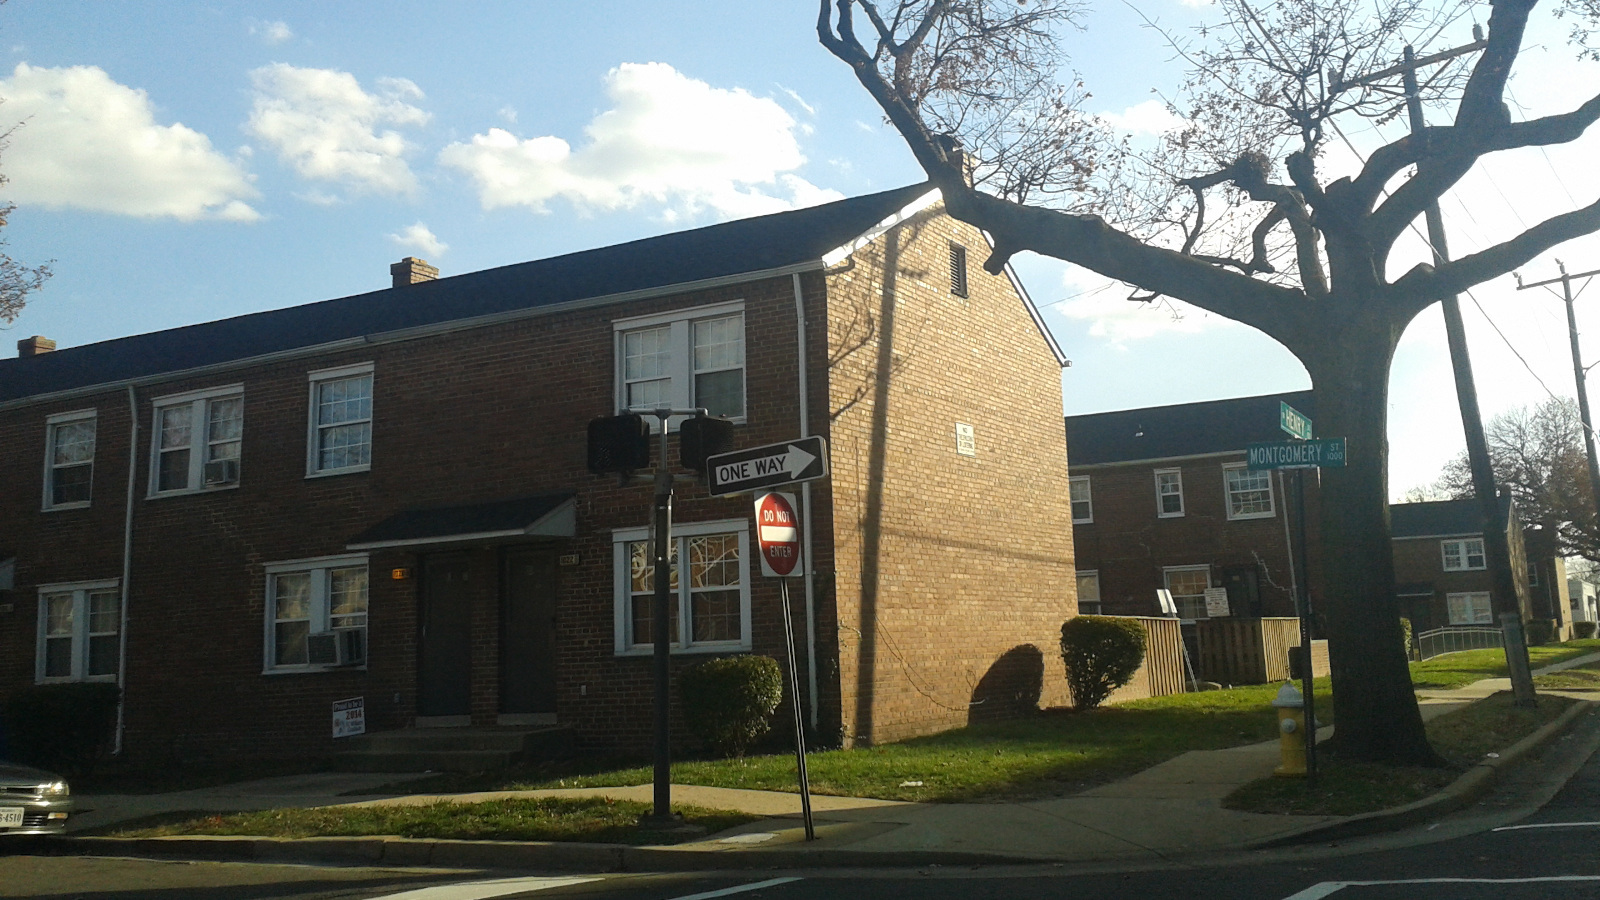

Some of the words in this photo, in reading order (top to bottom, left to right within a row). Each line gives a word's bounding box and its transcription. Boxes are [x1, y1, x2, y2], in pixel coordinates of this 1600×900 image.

[1285, 408, 1305, 436] HENRY
[1250, 444, 1322, 465] MONTGOMERY
[1330, 443, 1339, 451] ST
[1327, 452, 1343, 460] 1000
[720, 463, 750, 482] ONE
[755, 455, 786, 476] WAY
[764, 510, 774, 522] DO
[776, 511, 791, 523] NOT
[770, 545, 792, 558] ENTER
[346, 710, 362, 720] 2014
